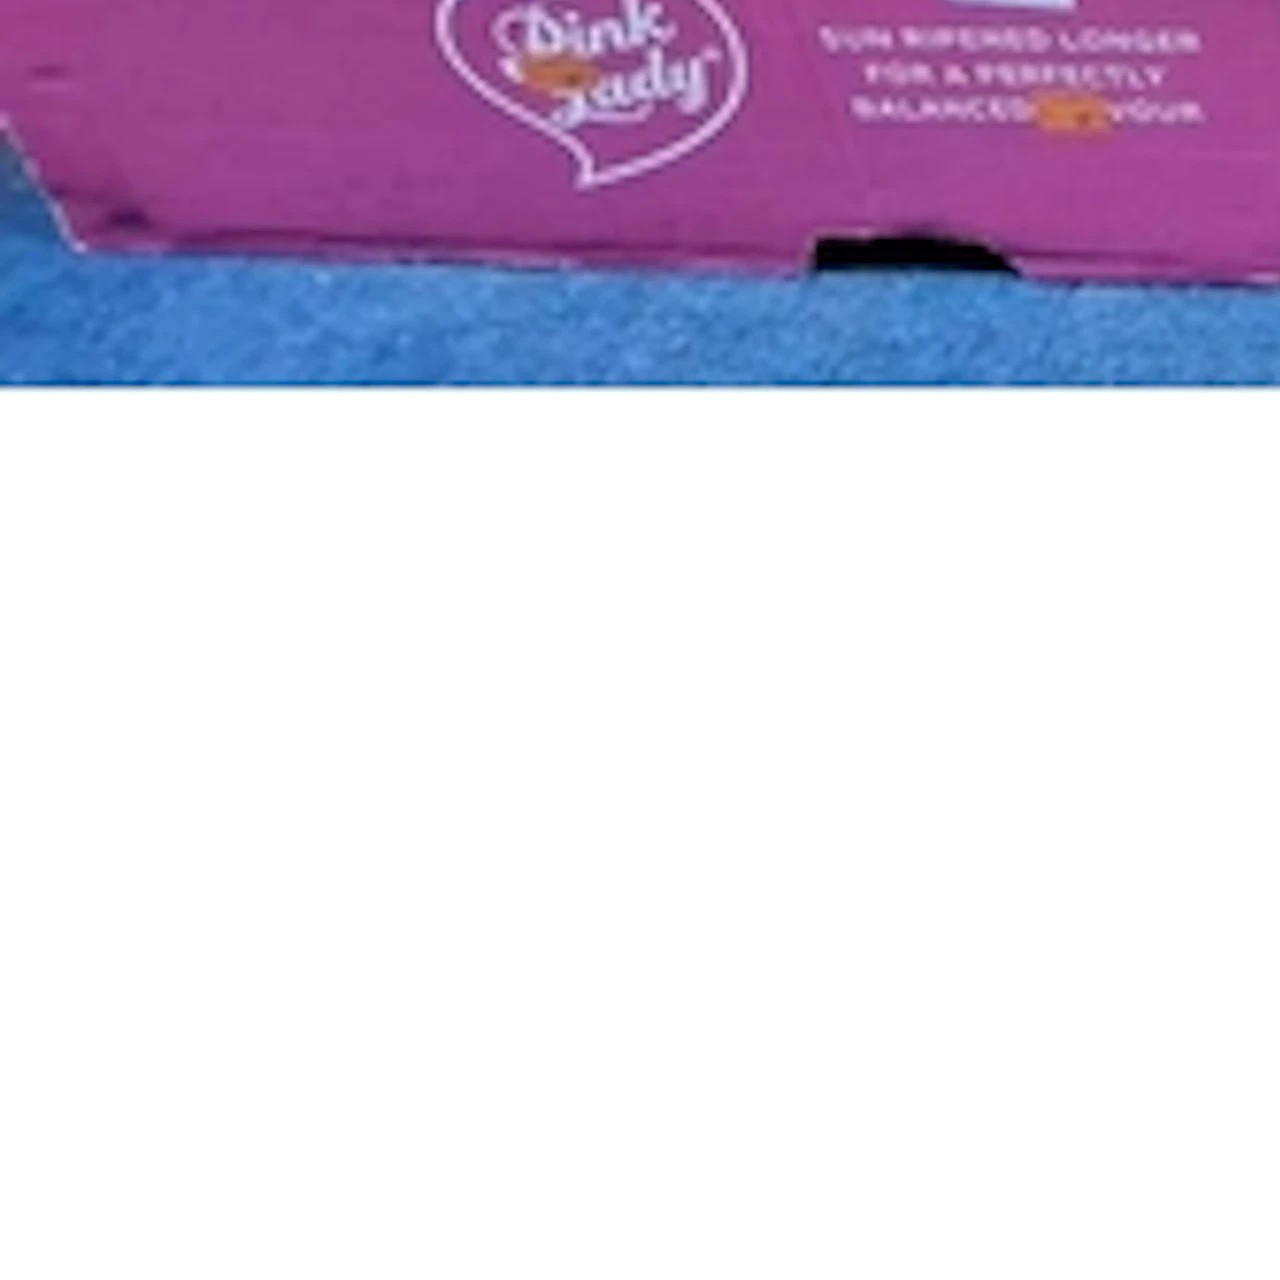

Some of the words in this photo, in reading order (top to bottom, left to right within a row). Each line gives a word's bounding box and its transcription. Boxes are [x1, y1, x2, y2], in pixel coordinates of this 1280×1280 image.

[818, 24, 894, 53] SUN
[901, 25, 1053, 54] RIPENED
[1057, 26, 1202, 54] LONGER
[863, 62, 934, 88] FOR
[942, 62, 970, 88] A
[974, 62, 1169, 91] PERFECTLY
[847, 95, 1032, 123] BALANCED
